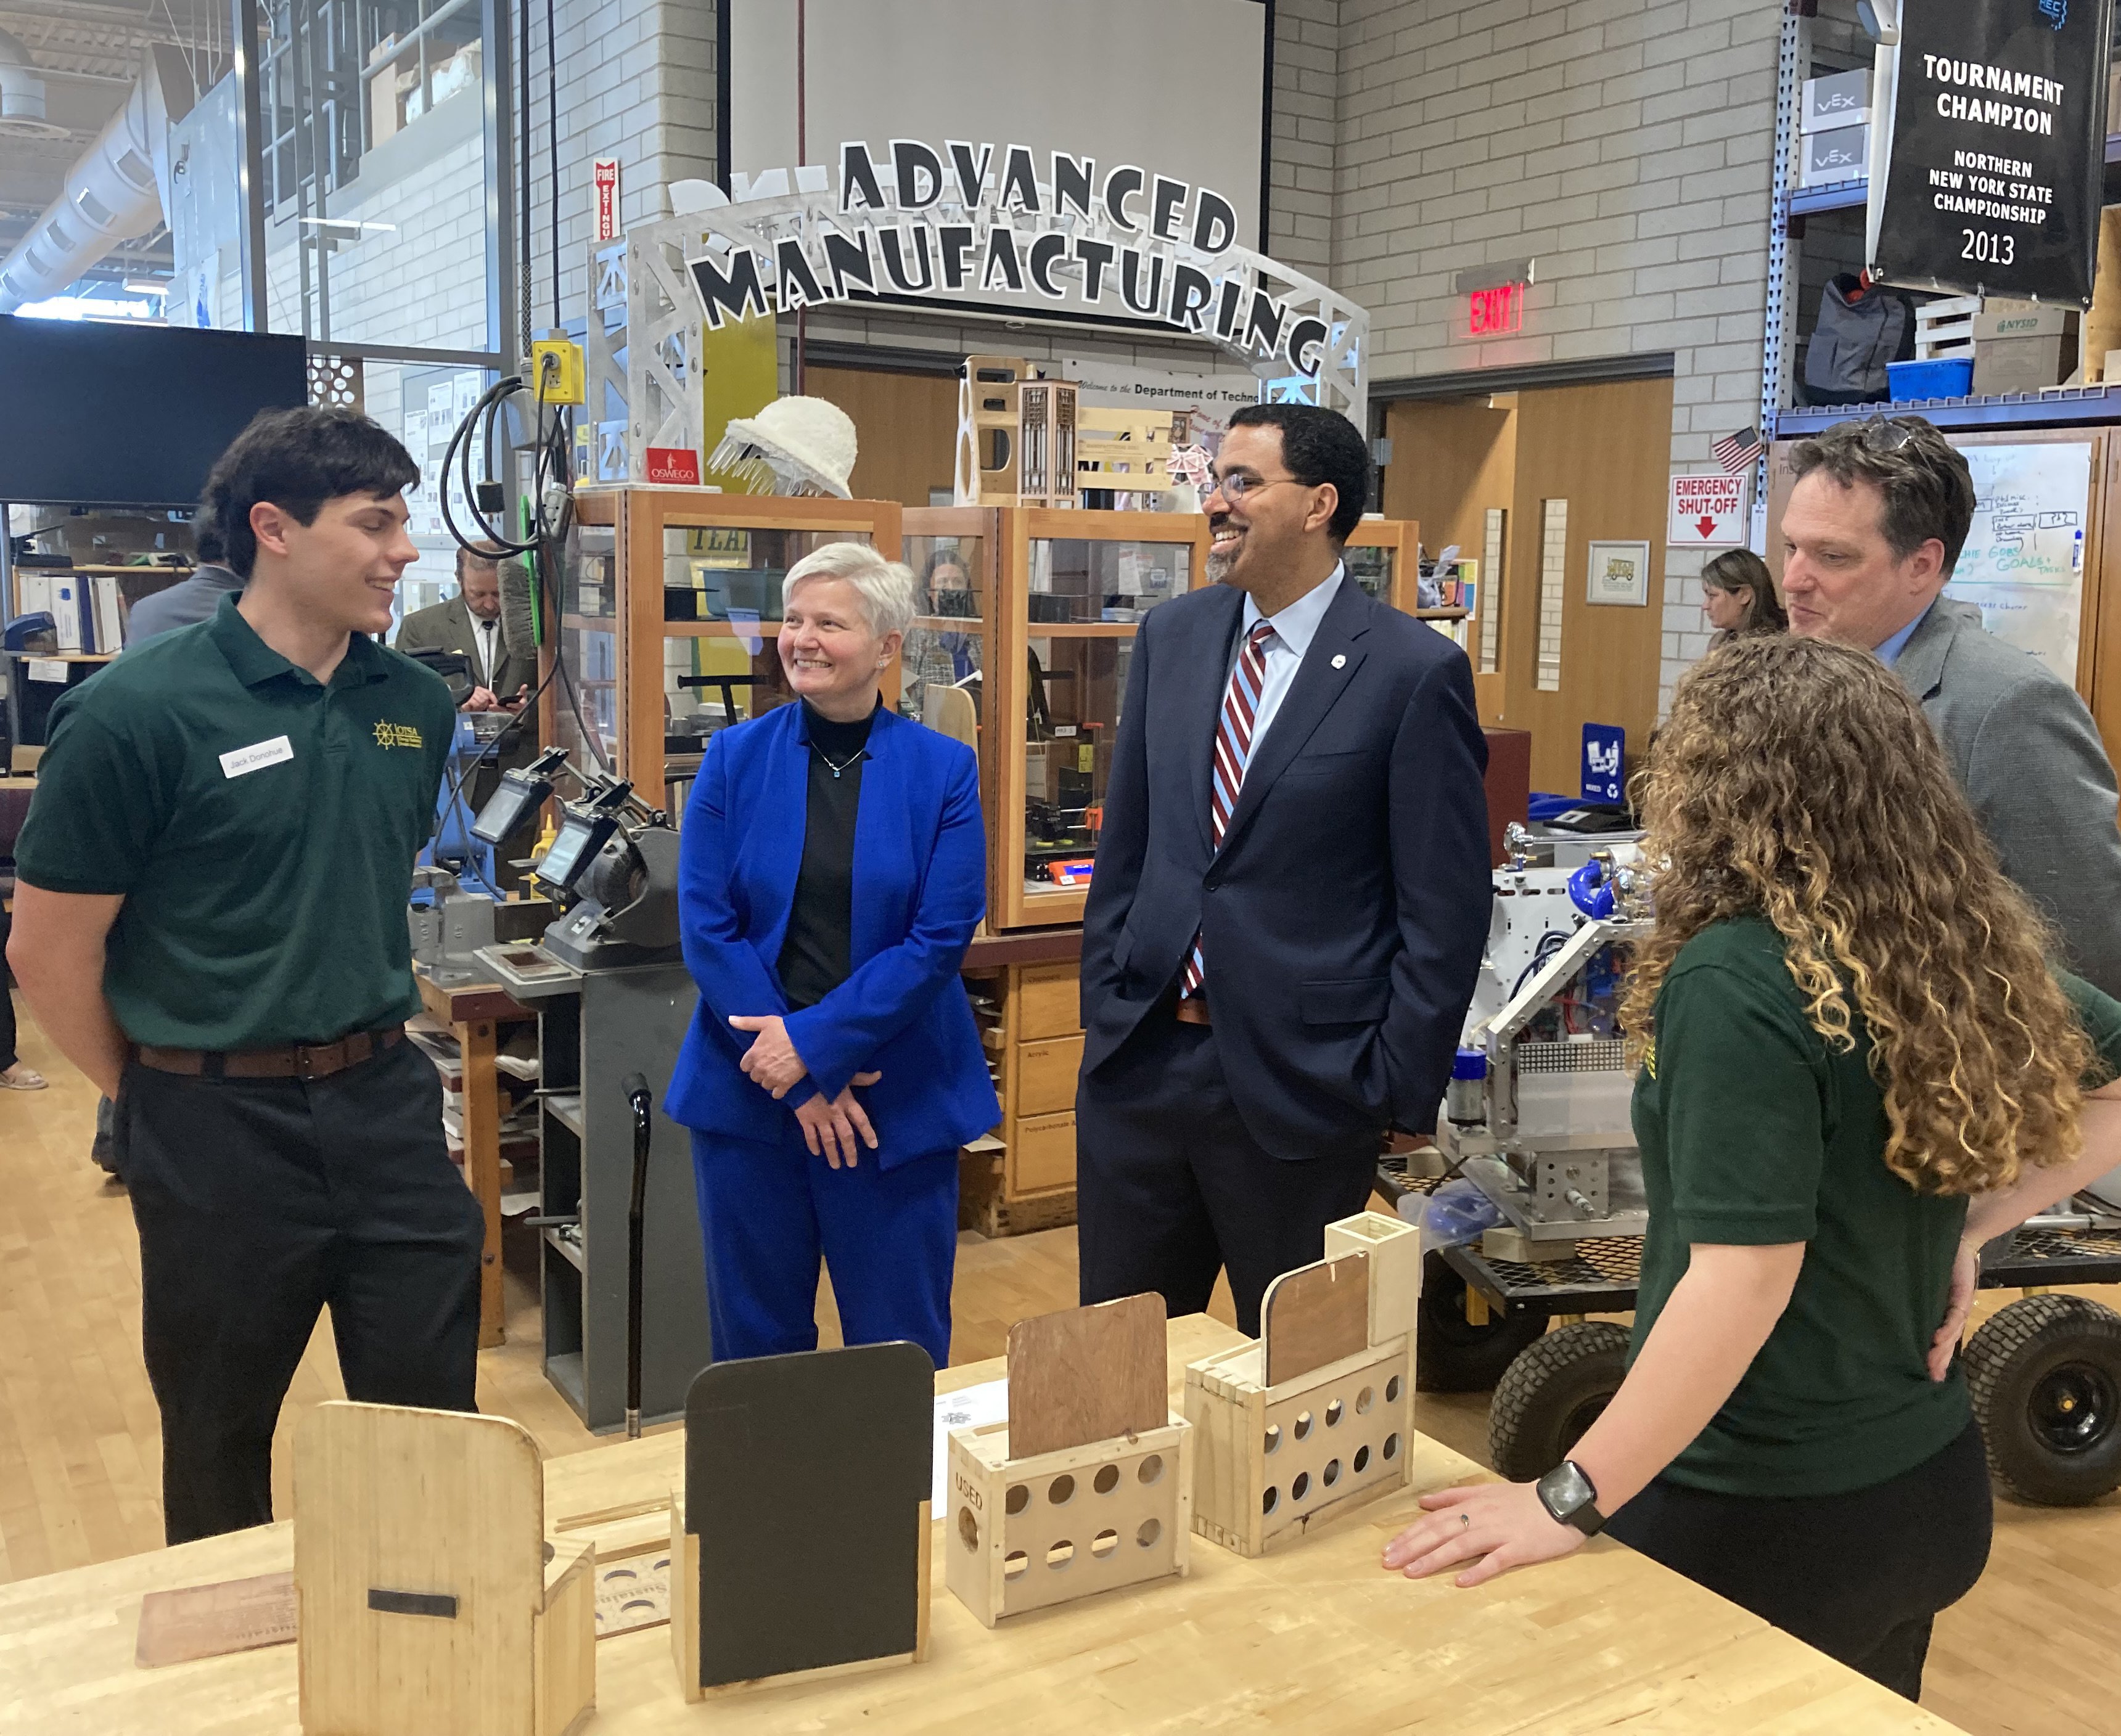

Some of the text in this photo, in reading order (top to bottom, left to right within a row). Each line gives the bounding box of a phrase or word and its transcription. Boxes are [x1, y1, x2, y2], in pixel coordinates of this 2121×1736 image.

[1924, 54, 2064, 106] TOURNAMENT
[1937, 93, 2052, 136] CHAMPION
[597, 168, 614, 181] FIRE
[1954, 150, 2033, 179] NORTHERN
[839, 139, 1237, 255] ADVANCED
[1929, 170, 2053, 204] NEW YORK STATE
[1934, 194, 2046, 224] CHAMPIONSHIP
[1961, 229, 2015, 266] 2013
[686, 223, 1329, 379] MANUFACTURING
[1471, 287, 1513, 334] EXIT
[2006, 318, 2038, 329] NYSID
[1078, 380, 1109, 391] Welcome
[1120, 383, 1131, 393] the
[1135, 384, 1203, 399] Department
[1206, 390, 1218, 400] of
[651, 469, 694, 479] OSWEGO
[1676, 479, 1742, 496] EMERGENCY
[1678, 498, 1738, 514] SHUT-OFF
[693, 530, 749, 551] TEA
[1996, 557, 2043, 571] GOALS
[230, 747, 284, 769] Jack Donohue
[956, 1472, 983, 1510] USED
